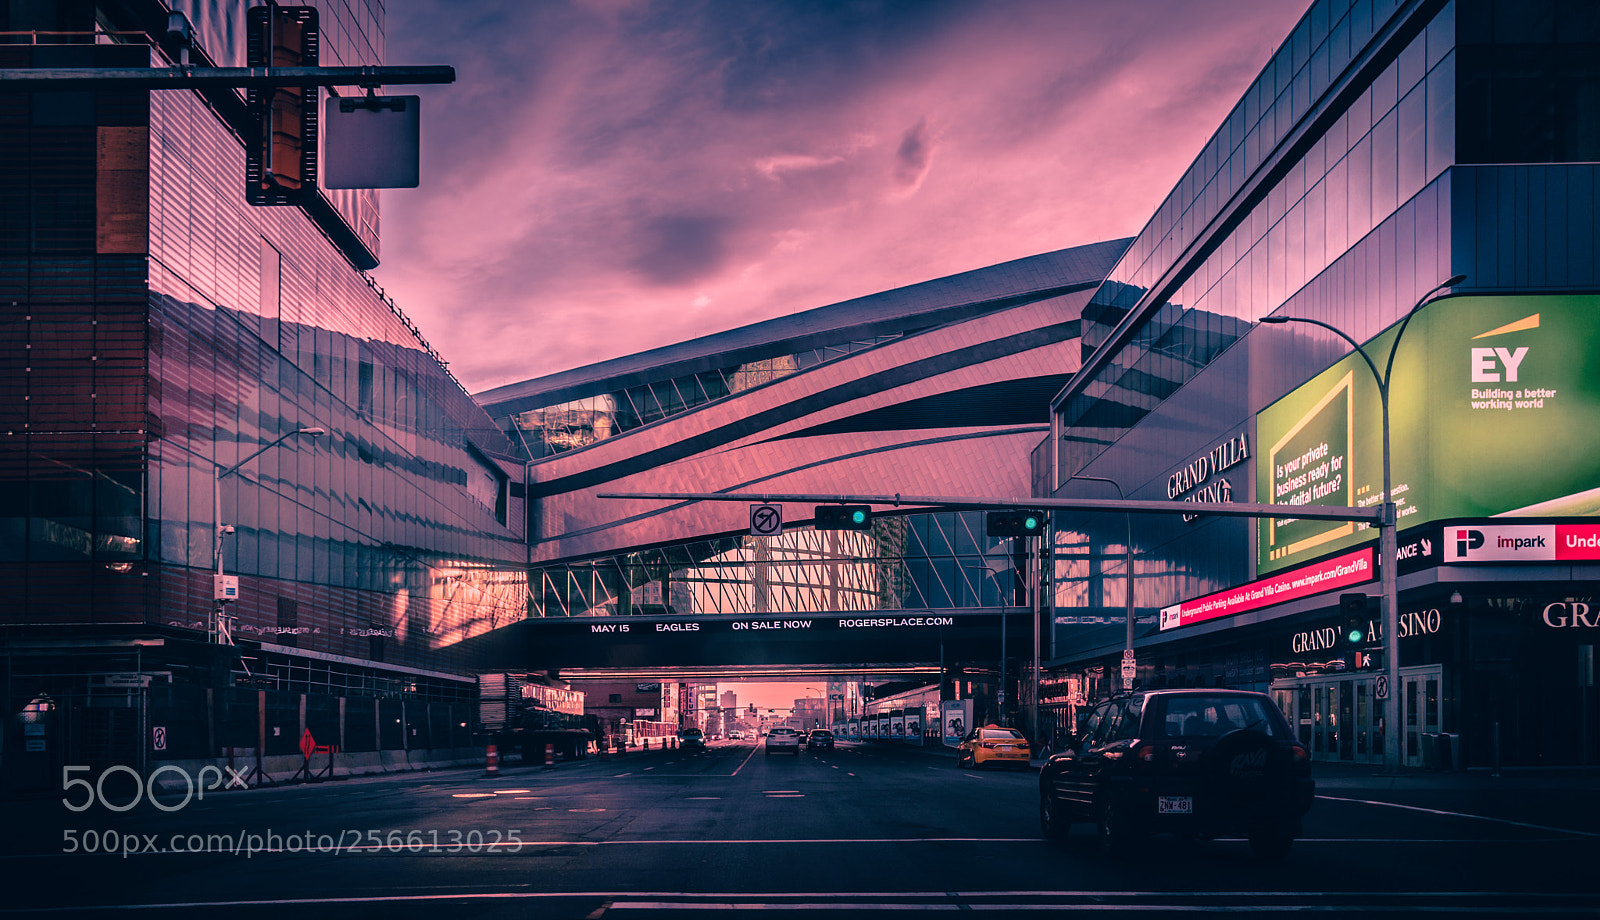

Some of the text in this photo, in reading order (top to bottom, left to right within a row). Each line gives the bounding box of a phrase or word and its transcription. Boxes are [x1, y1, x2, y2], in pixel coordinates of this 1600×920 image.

[1471, 347, 1530, 383] EY
[1471, 388, 1557, 401] Building a better
[1471, 398, 1544, 411] working world
[1167, 432, 1247, 500] GRAND VILLA
[1276, 442, 1329, 479] Is your private
[1276, 455, 1343, 498] business ready for
[1312, 474, 1342, 501] future?
[1497, 535, 1546, 551] impark
[1213, 598, 1227, 610] Parking
[1227, 592, 1245, 606] Available
[1251, 586, 1264, 600] Grand
[1264, 584, 1275, 596] Villa
[1274, 581, 1292, 594] Casino.
[1292, 558, 1368, 588] www.impark.com/GrandVilla
[591, 617, 953, 633] MAY 15 EAGLES ON SALE NOW ROGERSPLACE.COM
[1292, 627, 1336, 654] GRAND
